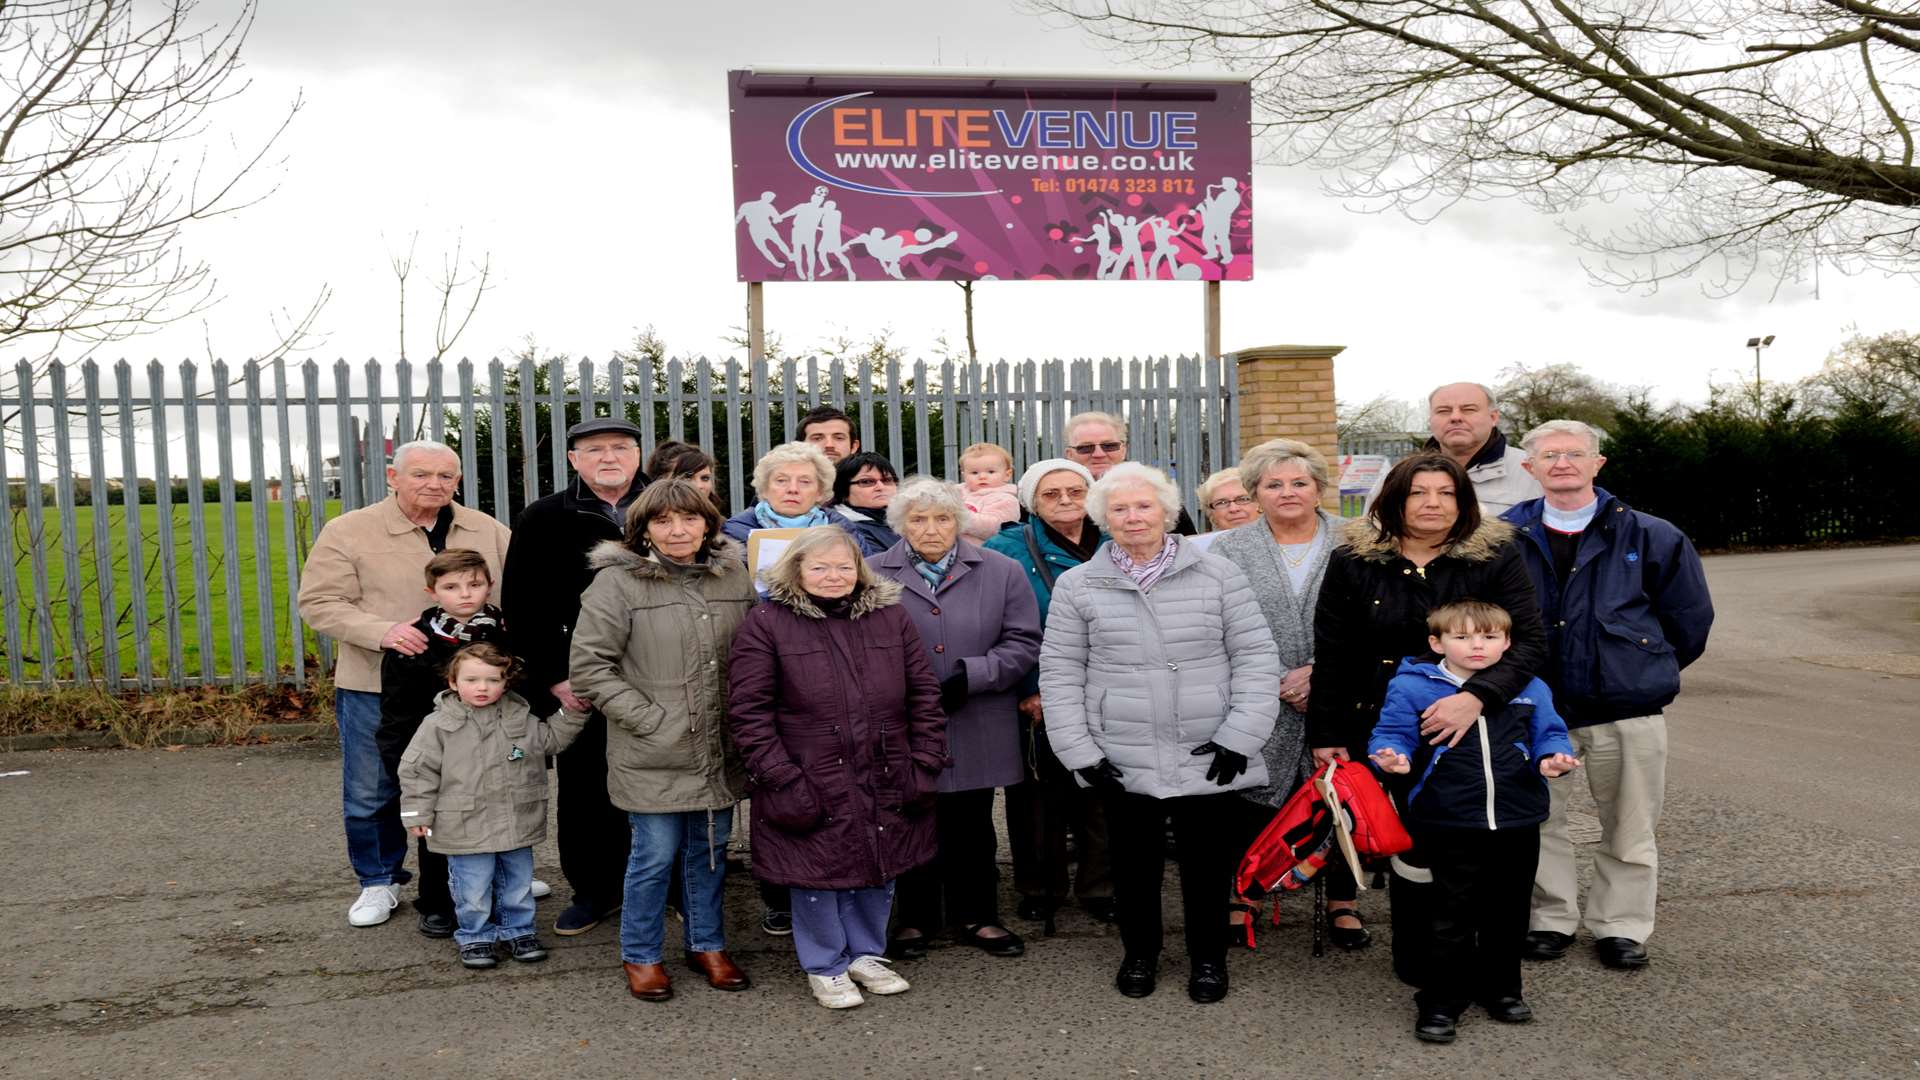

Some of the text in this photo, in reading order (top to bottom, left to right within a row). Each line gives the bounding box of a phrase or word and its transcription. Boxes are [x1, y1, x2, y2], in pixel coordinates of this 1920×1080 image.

[834, 149, 1195, 170] www.elitevenue.co.uk
[1032, 178, 1194, 193] Tel: 01474 323 817
